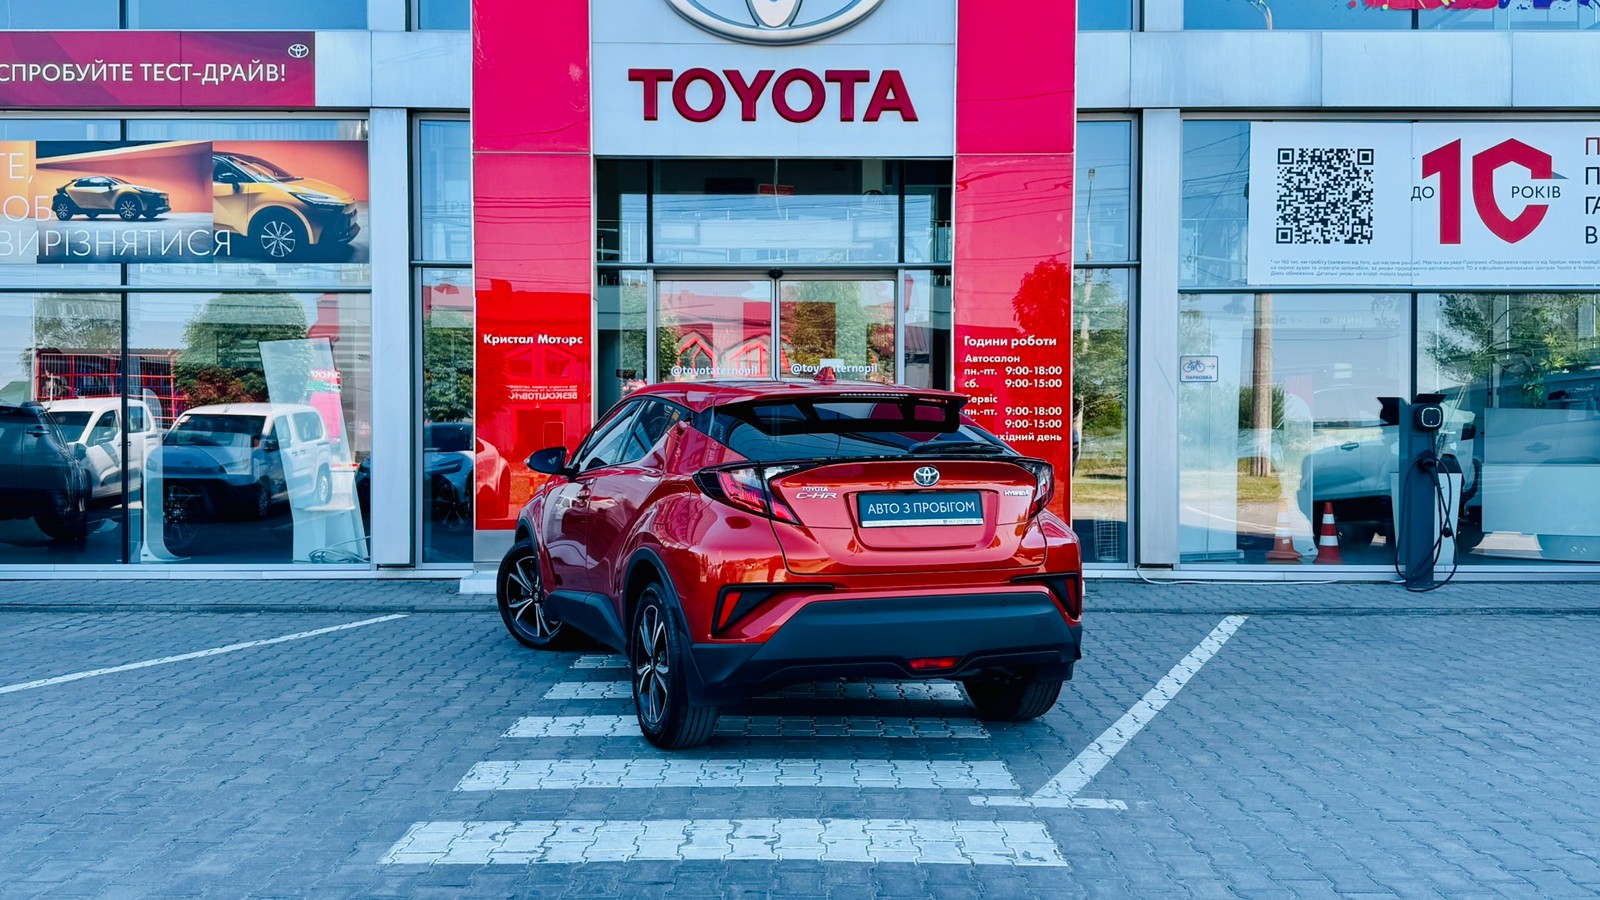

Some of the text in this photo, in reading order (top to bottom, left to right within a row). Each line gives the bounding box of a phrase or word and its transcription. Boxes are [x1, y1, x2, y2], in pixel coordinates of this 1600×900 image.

[140, 60, 287, 84] ТЕСТ-ДРАЙВ!
[628, 68, 919, 122] TOYOTA
[0, 152, 34, 184] Е,
[1410, 186, 1435, 202] ДО
[1511, 186, 1561, 199] РОКІВ
[483, 333, 583, 346] Кристал Моторс
[964, 335, 1057, 349] Години роботи
[965, 354, 1021, 363] Автосалон
[670, 365, 758, 378] @toyotaternopil
[790, 363, 878, 375] @toyternopil
[964, 366, 1062, 375] пн.-пт. 9:00-18:00
[964, 378, 1062, 388] сб. 9:00-15:00
[1005, 406, 1062, 416] 9:00-18:00
[1005, 419, 1062, 428] 9:00-15:00
[995, 432, 1062, 442] хідний день
[867, 501, 975, 515] АВТО З ПРОБІГОМ
